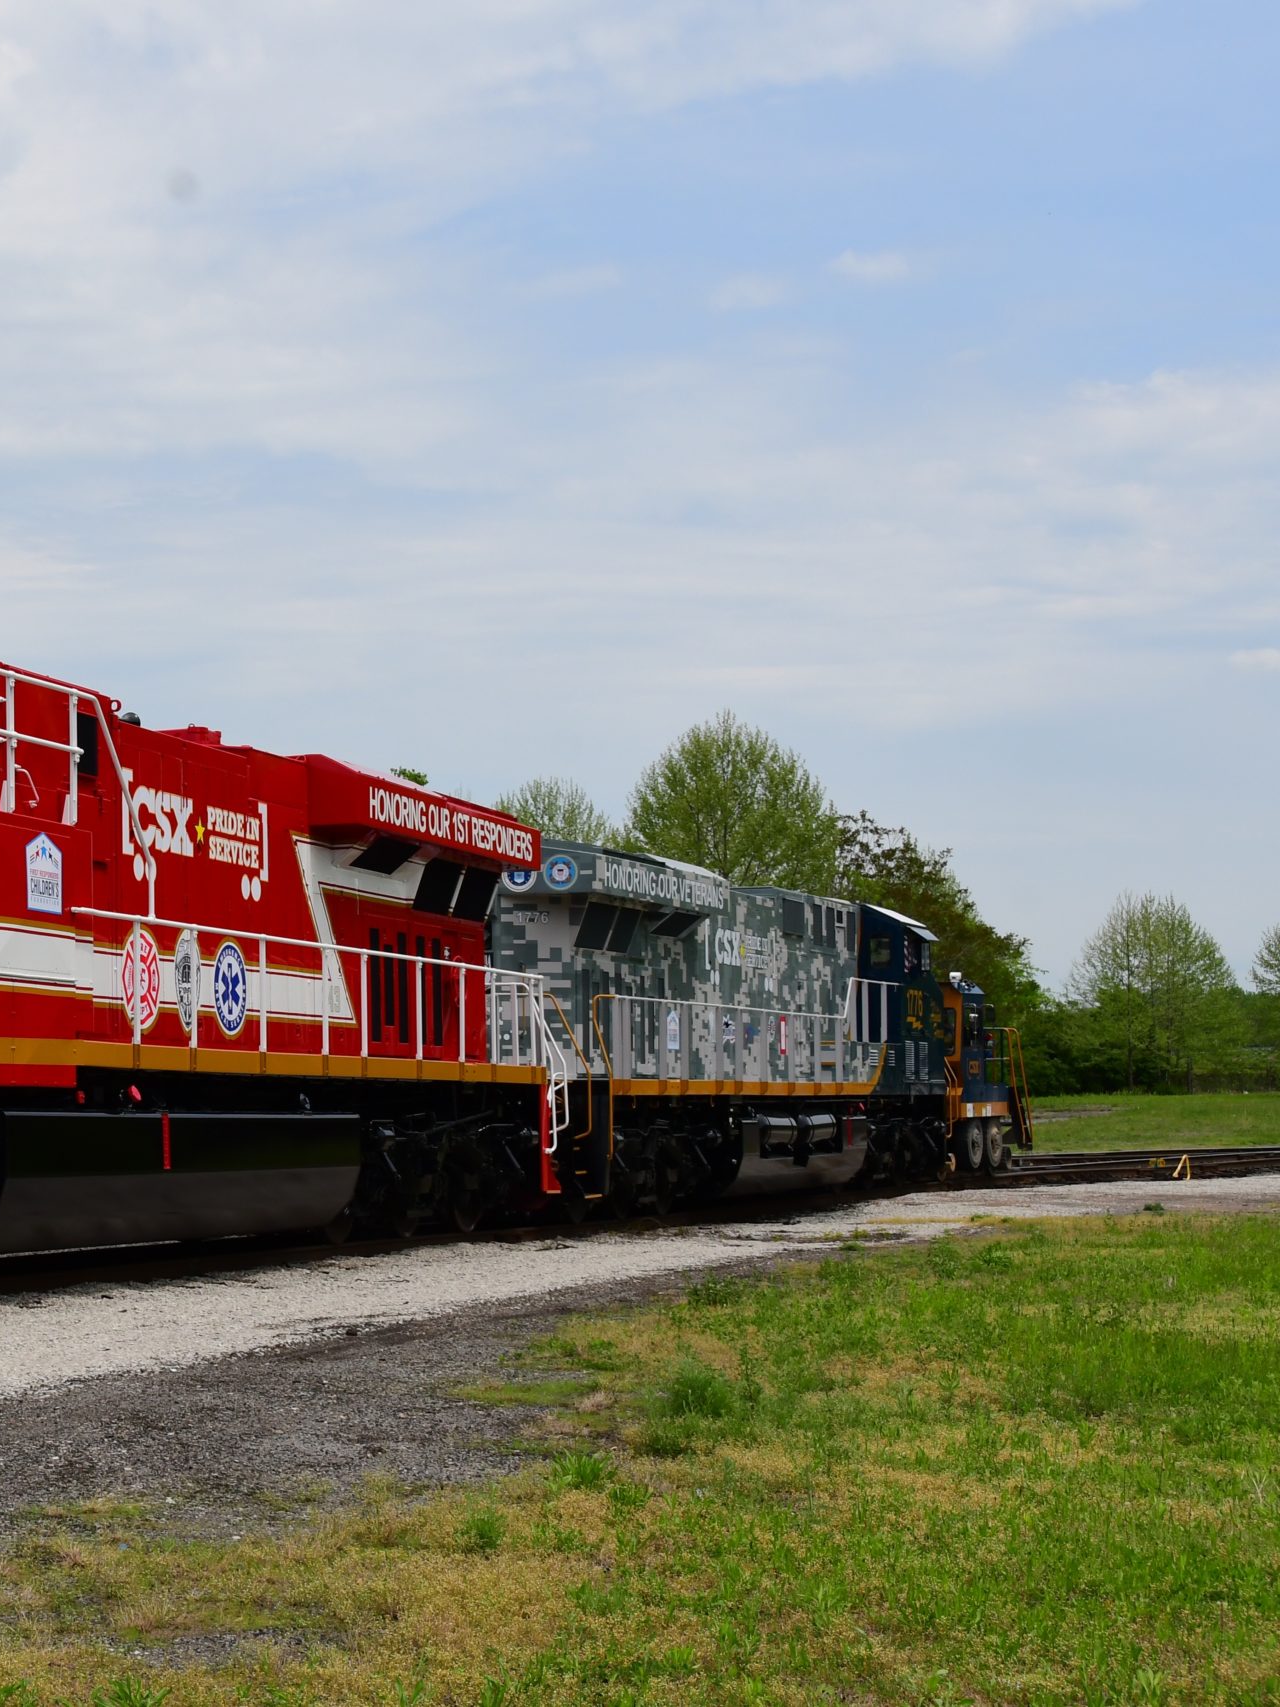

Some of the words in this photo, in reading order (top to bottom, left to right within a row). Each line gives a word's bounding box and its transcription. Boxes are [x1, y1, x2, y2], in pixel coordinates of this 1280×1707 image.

[132, 785, 194, 858] CSX
[206, 805, 245, 838] PRIDE
[246, 817, 260, 842] IN
[369, 786, 427, 833] HONORING
[428, 804, 451, 840] OUR
[452, 811, 470, 845] 1ST
[471, 816, 533, 862] RESPONDERS
[208, 835, 260, 869] SERVICE
[604, 861, 657, 897] HONORING
[658, 873, 678, 900] OUR
[679, 878, 724, 910] VETERANS
[516, 911, 549, 924] 1776
[715, 928, 741, 966] CSX
[907, 988, 923, 1017] 1776
